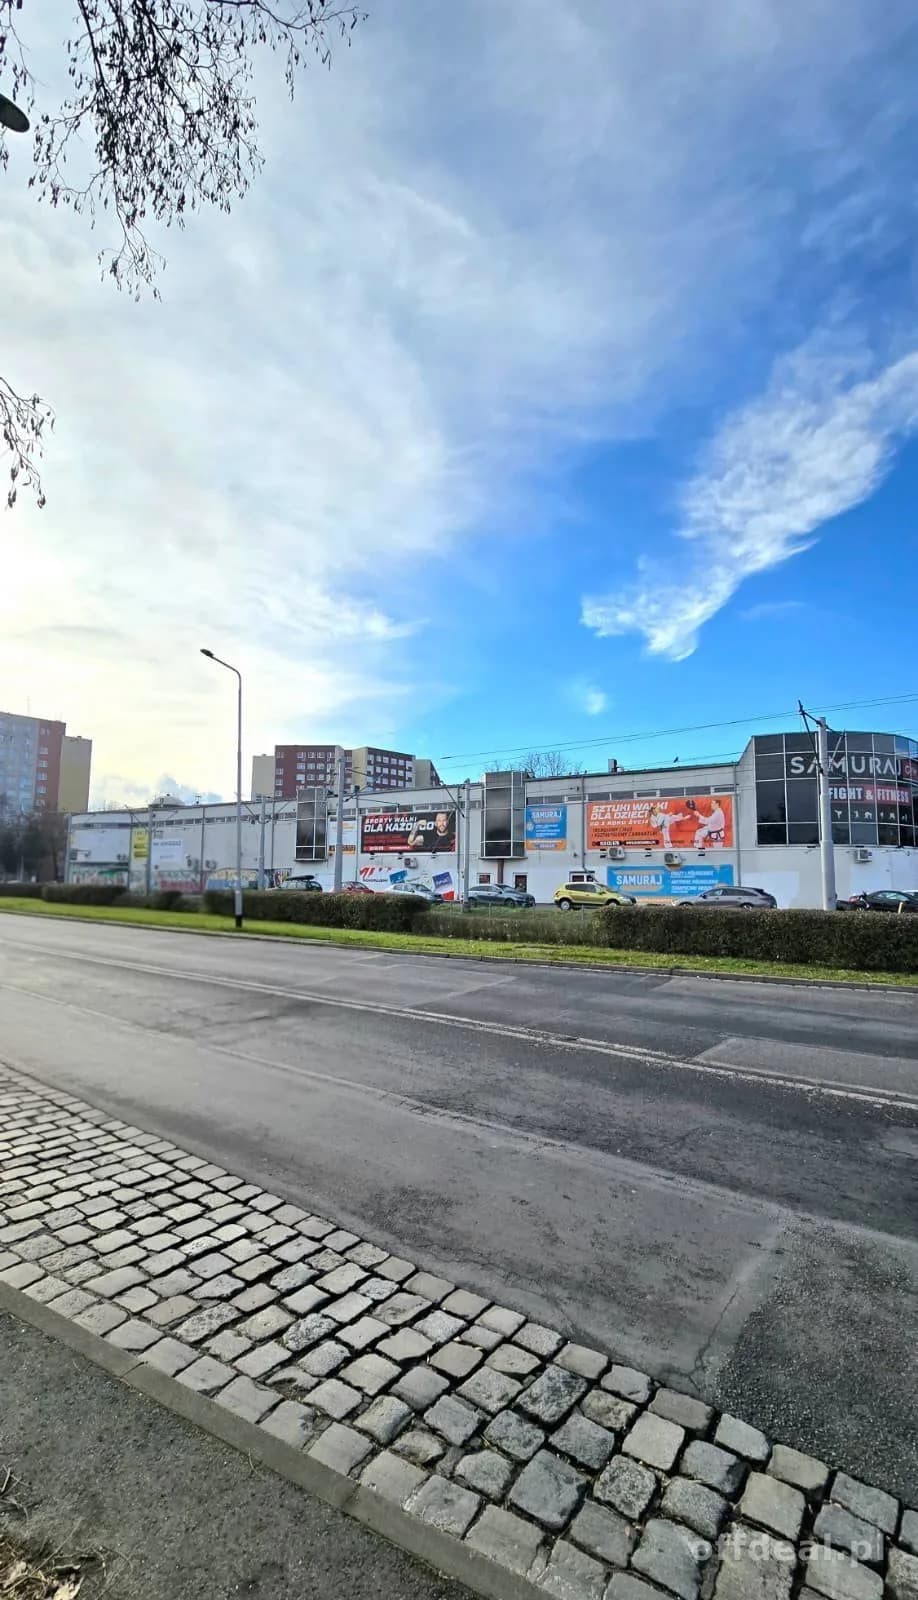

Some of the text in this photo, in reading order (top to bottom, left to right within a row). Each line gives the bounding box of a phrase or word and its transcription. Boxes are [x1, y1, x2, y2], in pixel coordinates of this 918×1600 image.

[828, 787, 909, 803] FIGHT & FITNESS
[591, 804, 630, 812] SZTUKI
[590, 811, 649, 820] DLA DZIECI
[364, 824, 384, 833] DLA
[616, 873, 662, 886] SAMURAJ
